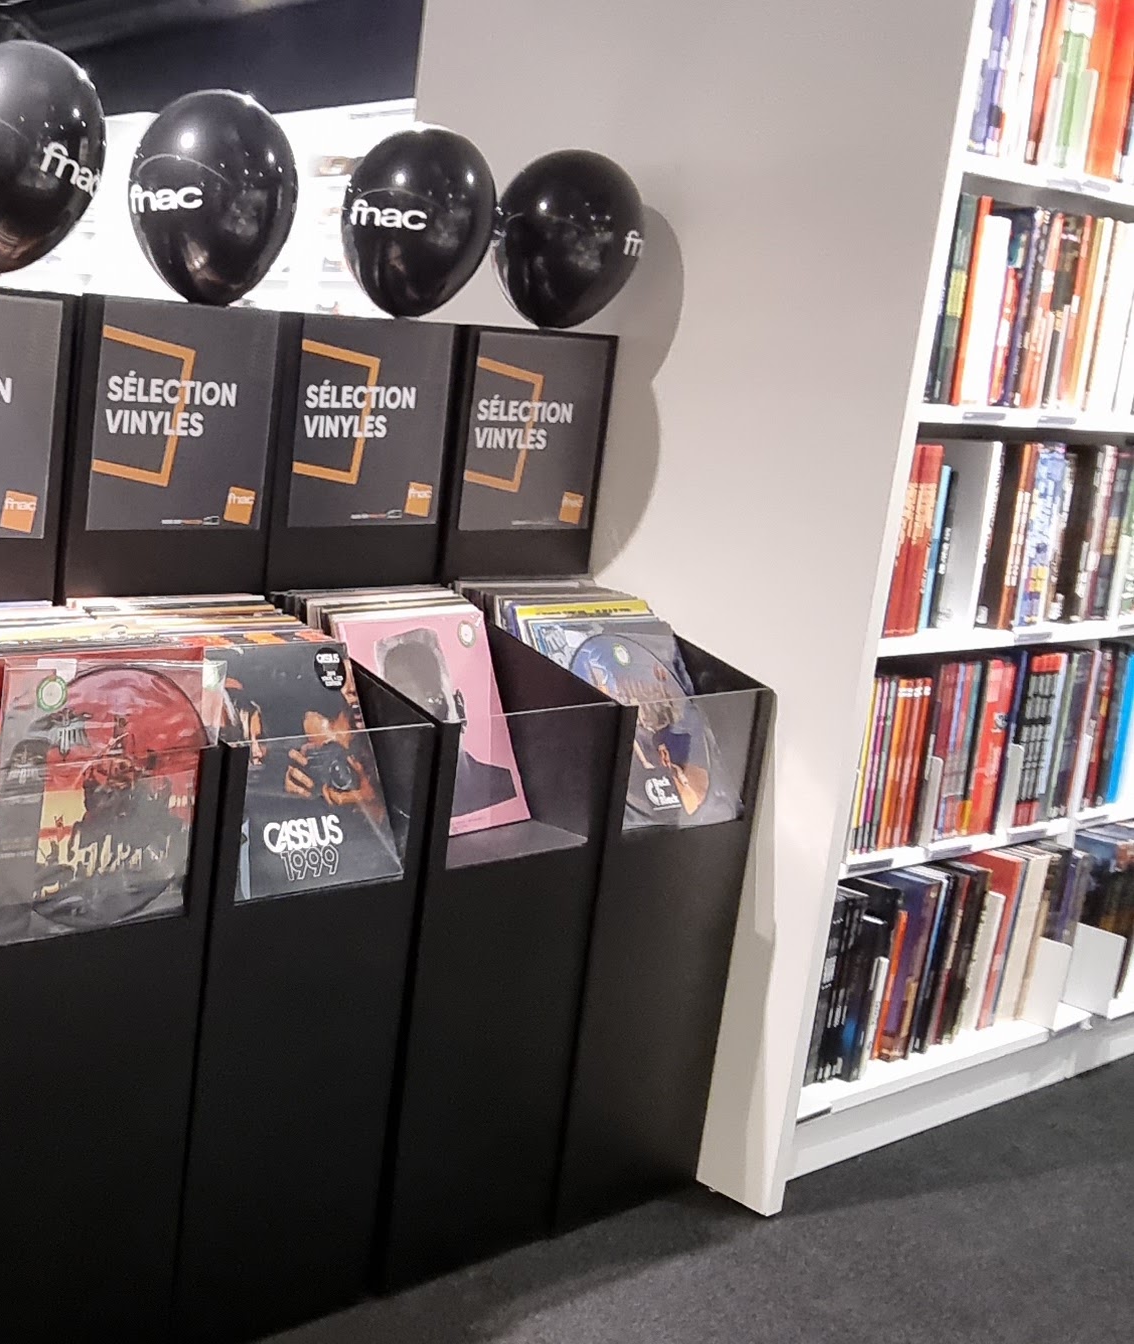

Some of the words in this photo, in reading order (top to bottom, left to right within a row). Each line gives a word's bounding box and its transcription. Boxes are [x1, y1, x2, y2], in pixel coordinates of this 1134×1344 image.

[129, 183, 203, 215] fnac
[350, 198, 428, 231] fnac
[623, 229, 643, 257] fn
[107, 370, 238, 407] SÉLECTION
[305, 378, 417, 409] SÉLECTION
[105, 408, 204, 437] VINYLES
[476, 394, 574, 424] SÉLECTION
[303, 414, 388, 438] VINYLES
[474, 427, 548, 450] VINYLES
[4, 497, 37, 512] fnac
[227, 492, 255, 506] fnac
[263, 814, 344, 853] CASSIUS
[280, 843, 339, 882] 1999
